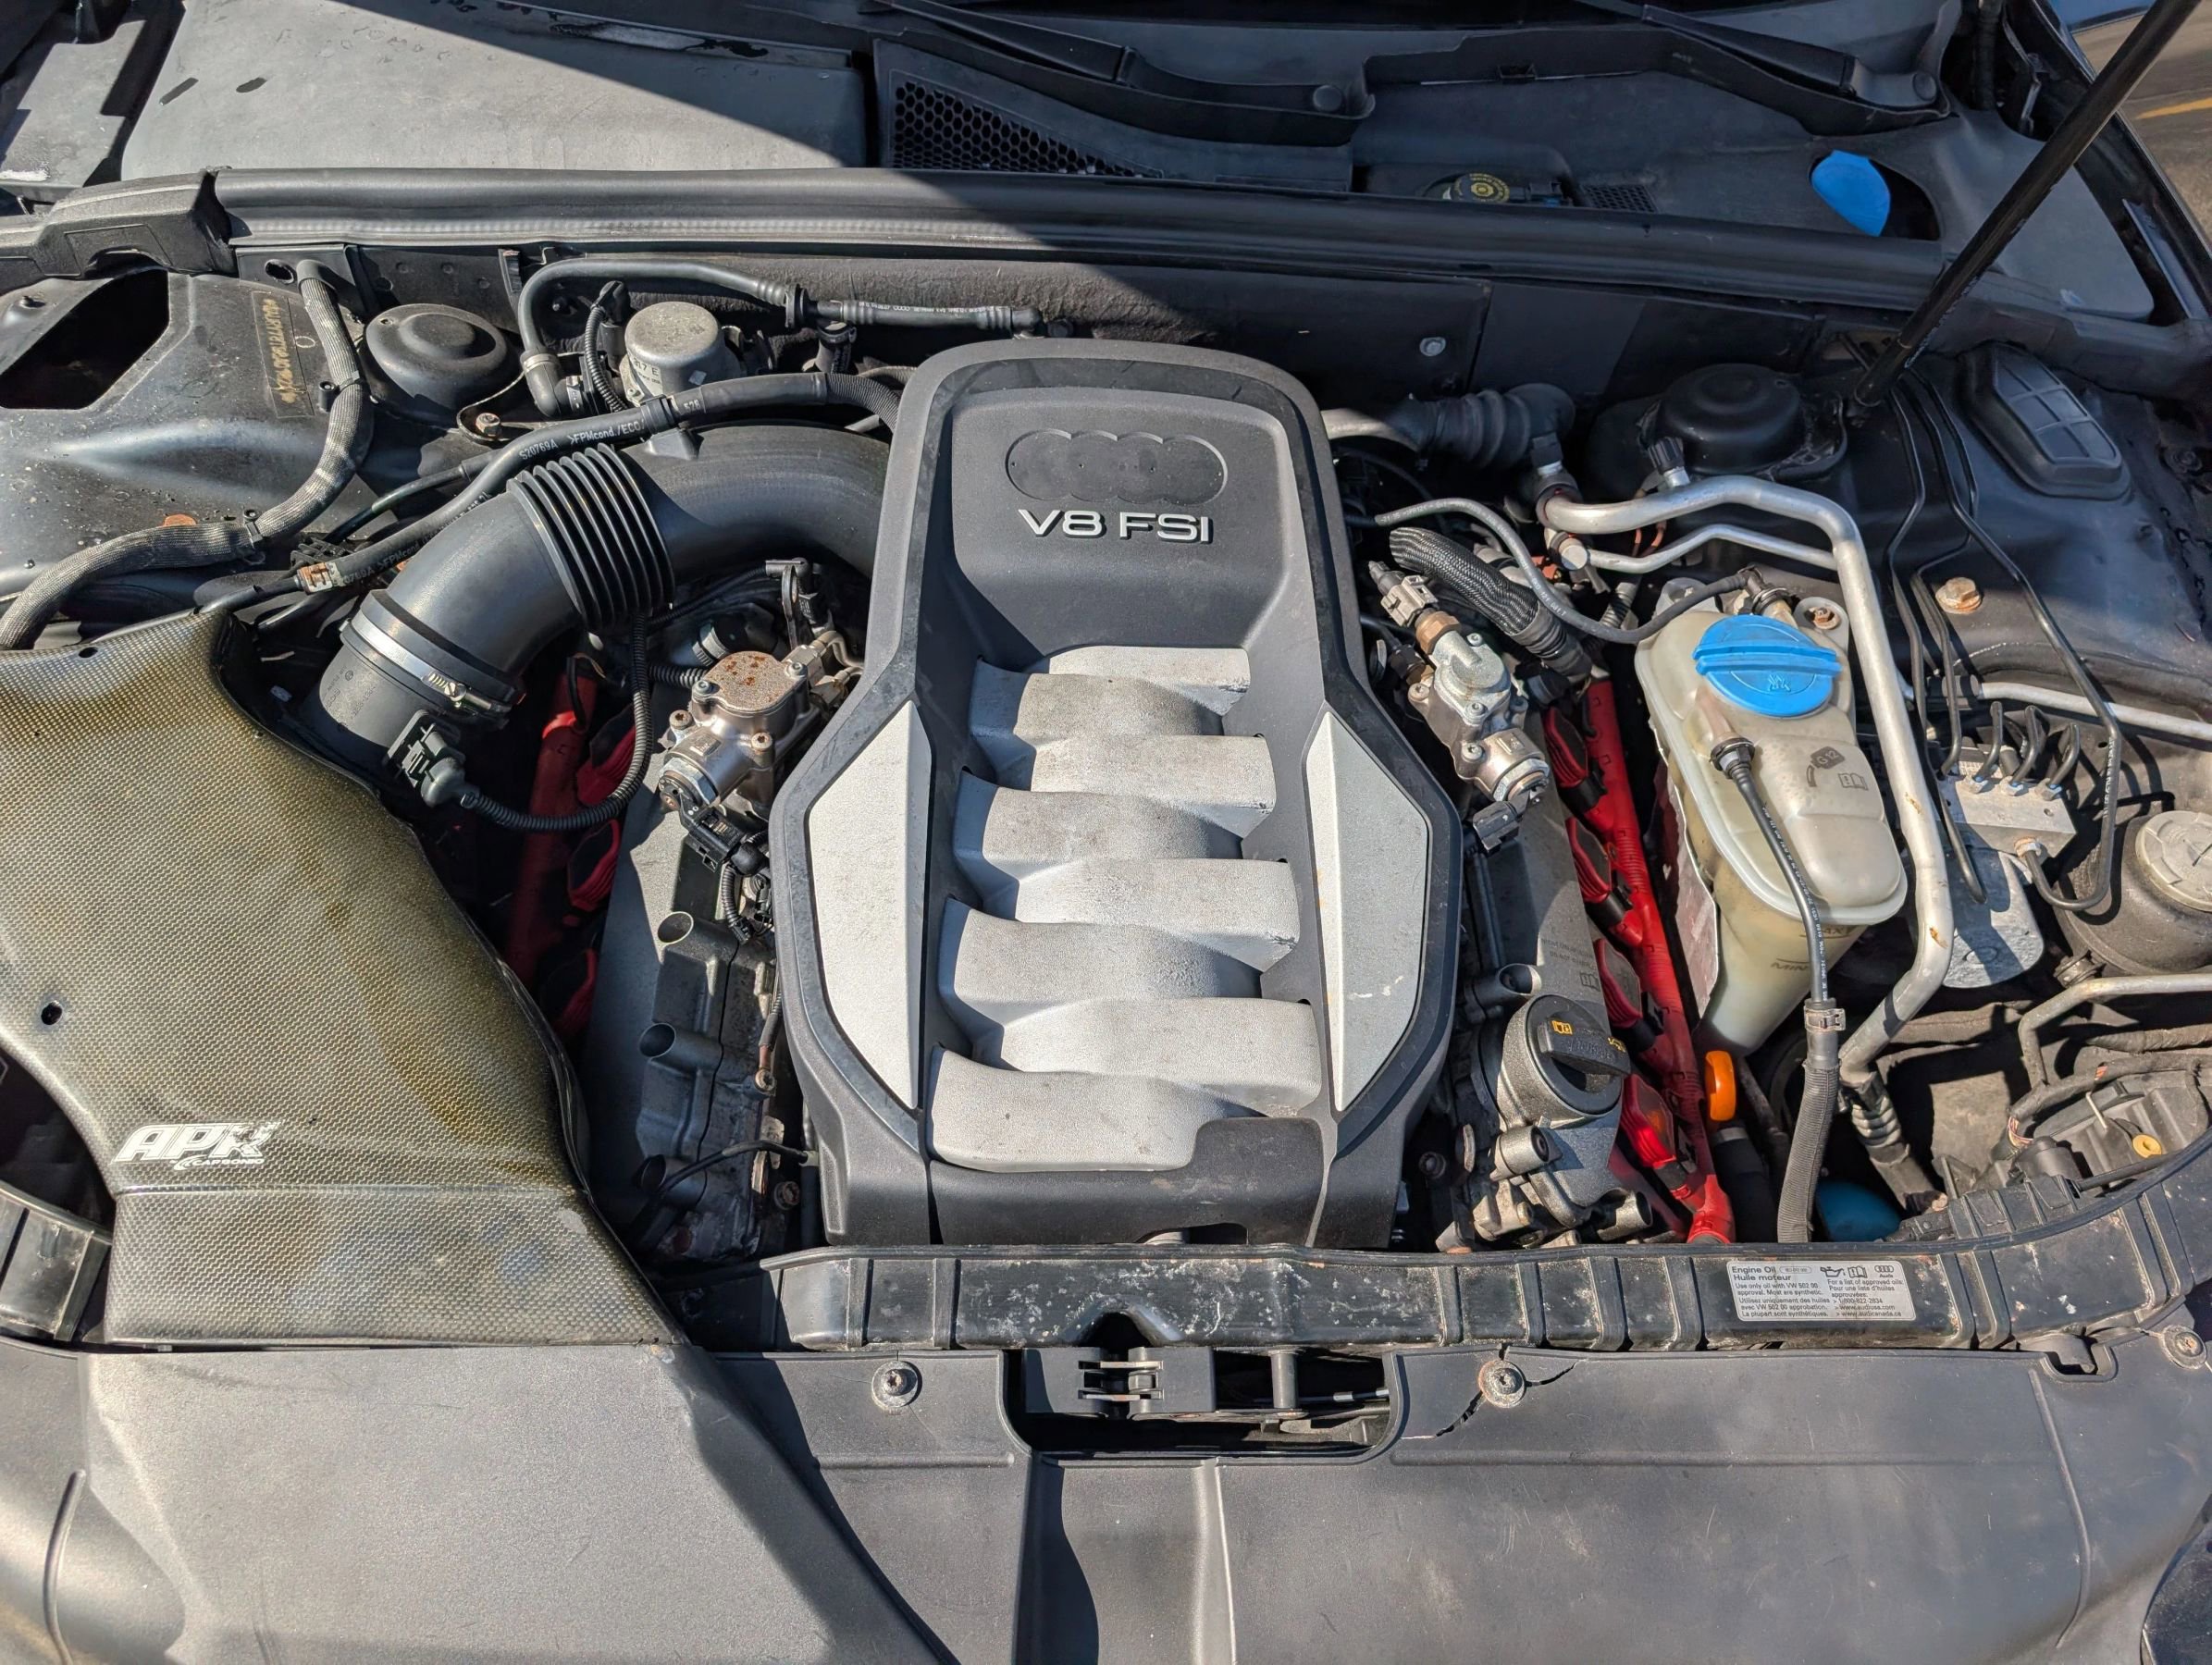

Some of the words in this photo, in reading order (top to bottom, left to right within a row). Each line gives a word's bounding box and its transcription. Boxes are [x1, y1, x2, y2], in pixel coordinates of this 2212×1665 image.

[519, 440, 559, 460] S20769A
[1019, 510, 1104, 536] V8
[1119, 512, 1210, 542] FSI
